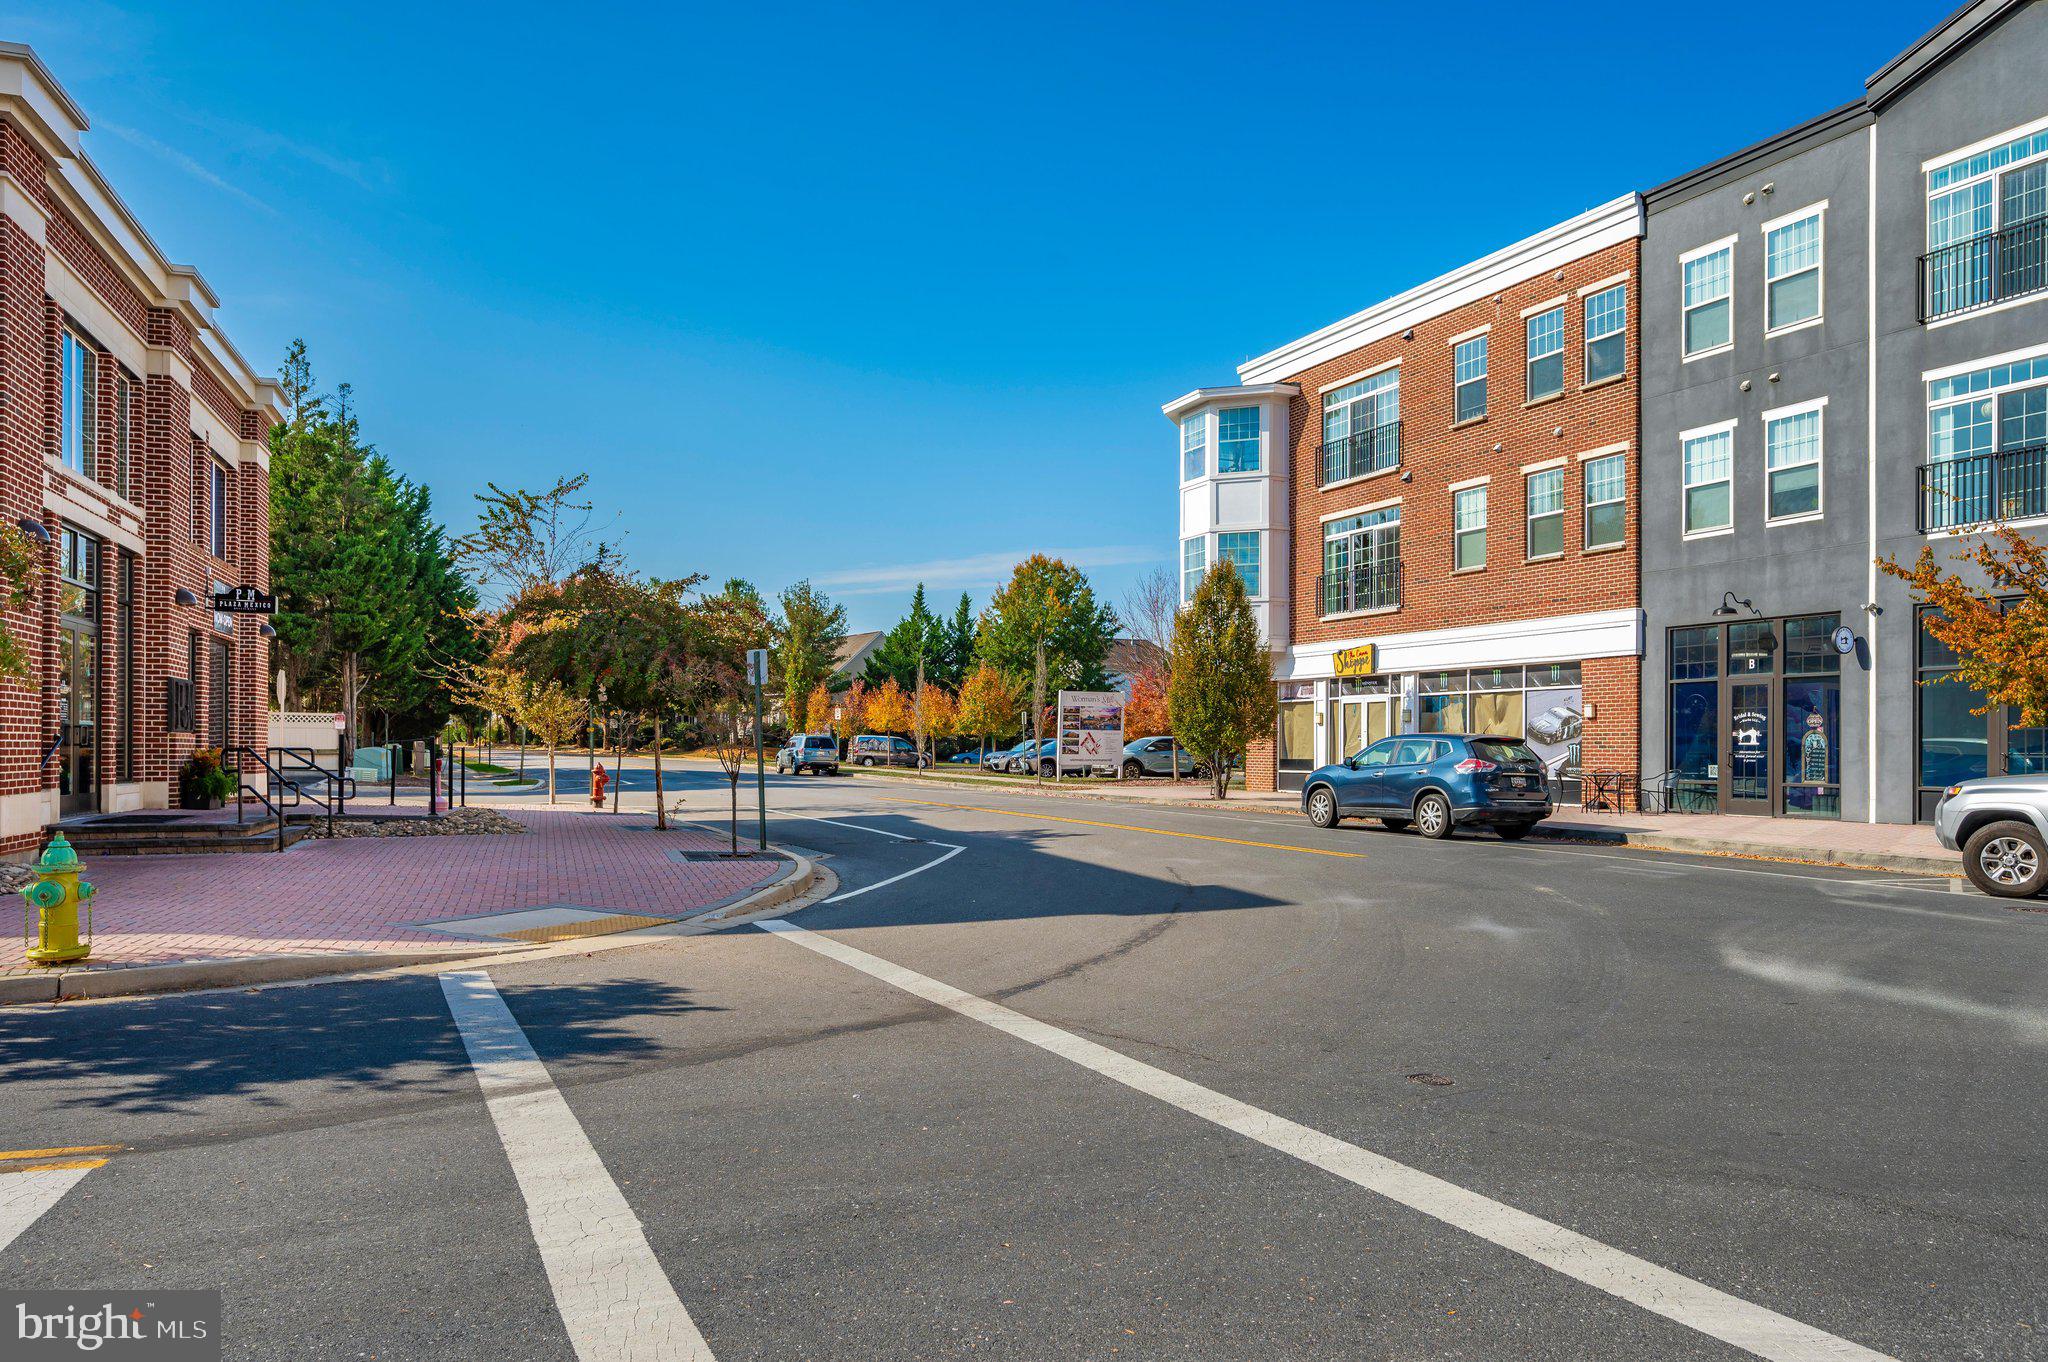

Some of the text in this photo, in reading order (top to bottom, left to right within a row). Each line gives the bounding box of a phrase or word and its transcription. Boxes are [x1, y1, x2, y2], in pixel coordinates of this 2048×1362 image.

[236, 589, 255, 600] P M
[1748, 658, 1755, 669] B
[1733, 713, 1746, 721] Bridal
[1752, 712, 1766, 721] Sewing
